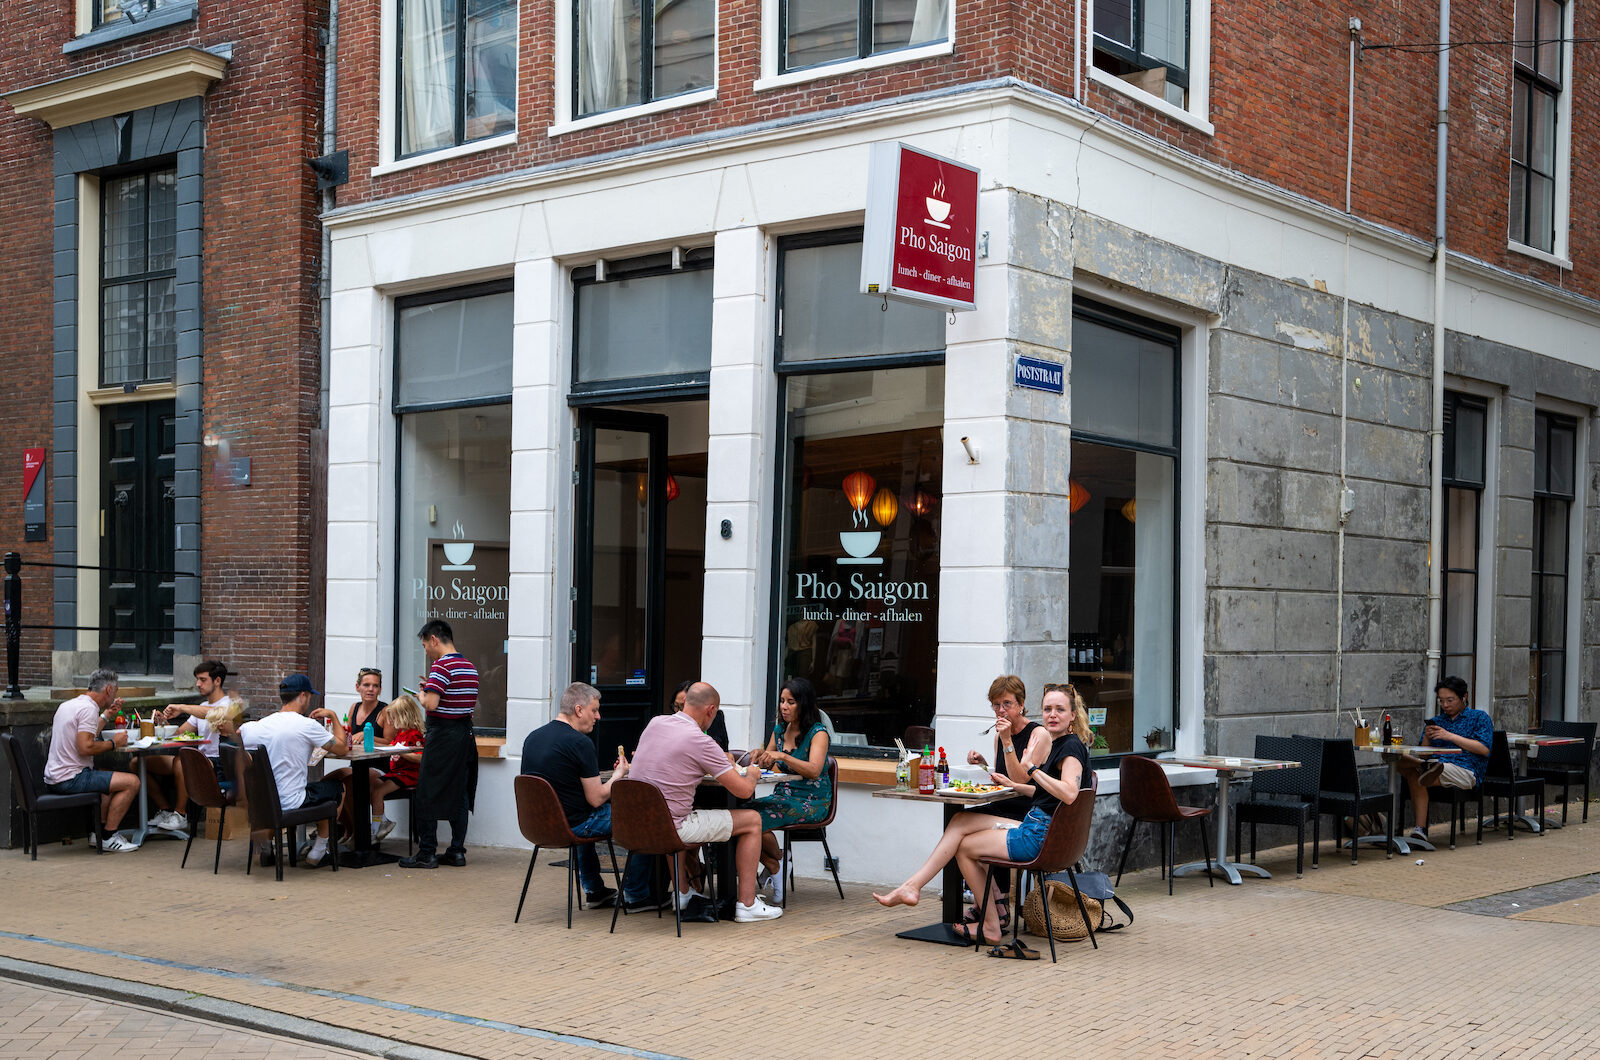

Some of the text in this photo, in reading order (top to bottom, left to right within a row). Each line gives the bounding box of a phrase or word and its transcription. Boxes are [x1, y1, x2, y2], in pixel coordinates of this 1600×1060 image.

[900, 226, 971, 262] Pho Saigon
[898, 263, 918, 278] lunch
[923, 269, 942, 283] diner
[946, 275, 971, 290] afhalen
[1016, 364, 1062, 385] POSTSTRAAT
[412, 577, 510, 606] Pho Saigon
[795, 572, 929, 606] Pho Saigon
[417, 607, 439, 619] lunch
[445, 607, 468, 619] diner
[473, 607, 505, 620] afhalen
[802, 607, 833, 621] lunch
[842, 608, 872, 621] diner
[880, 608, 923, 622] afhalen
